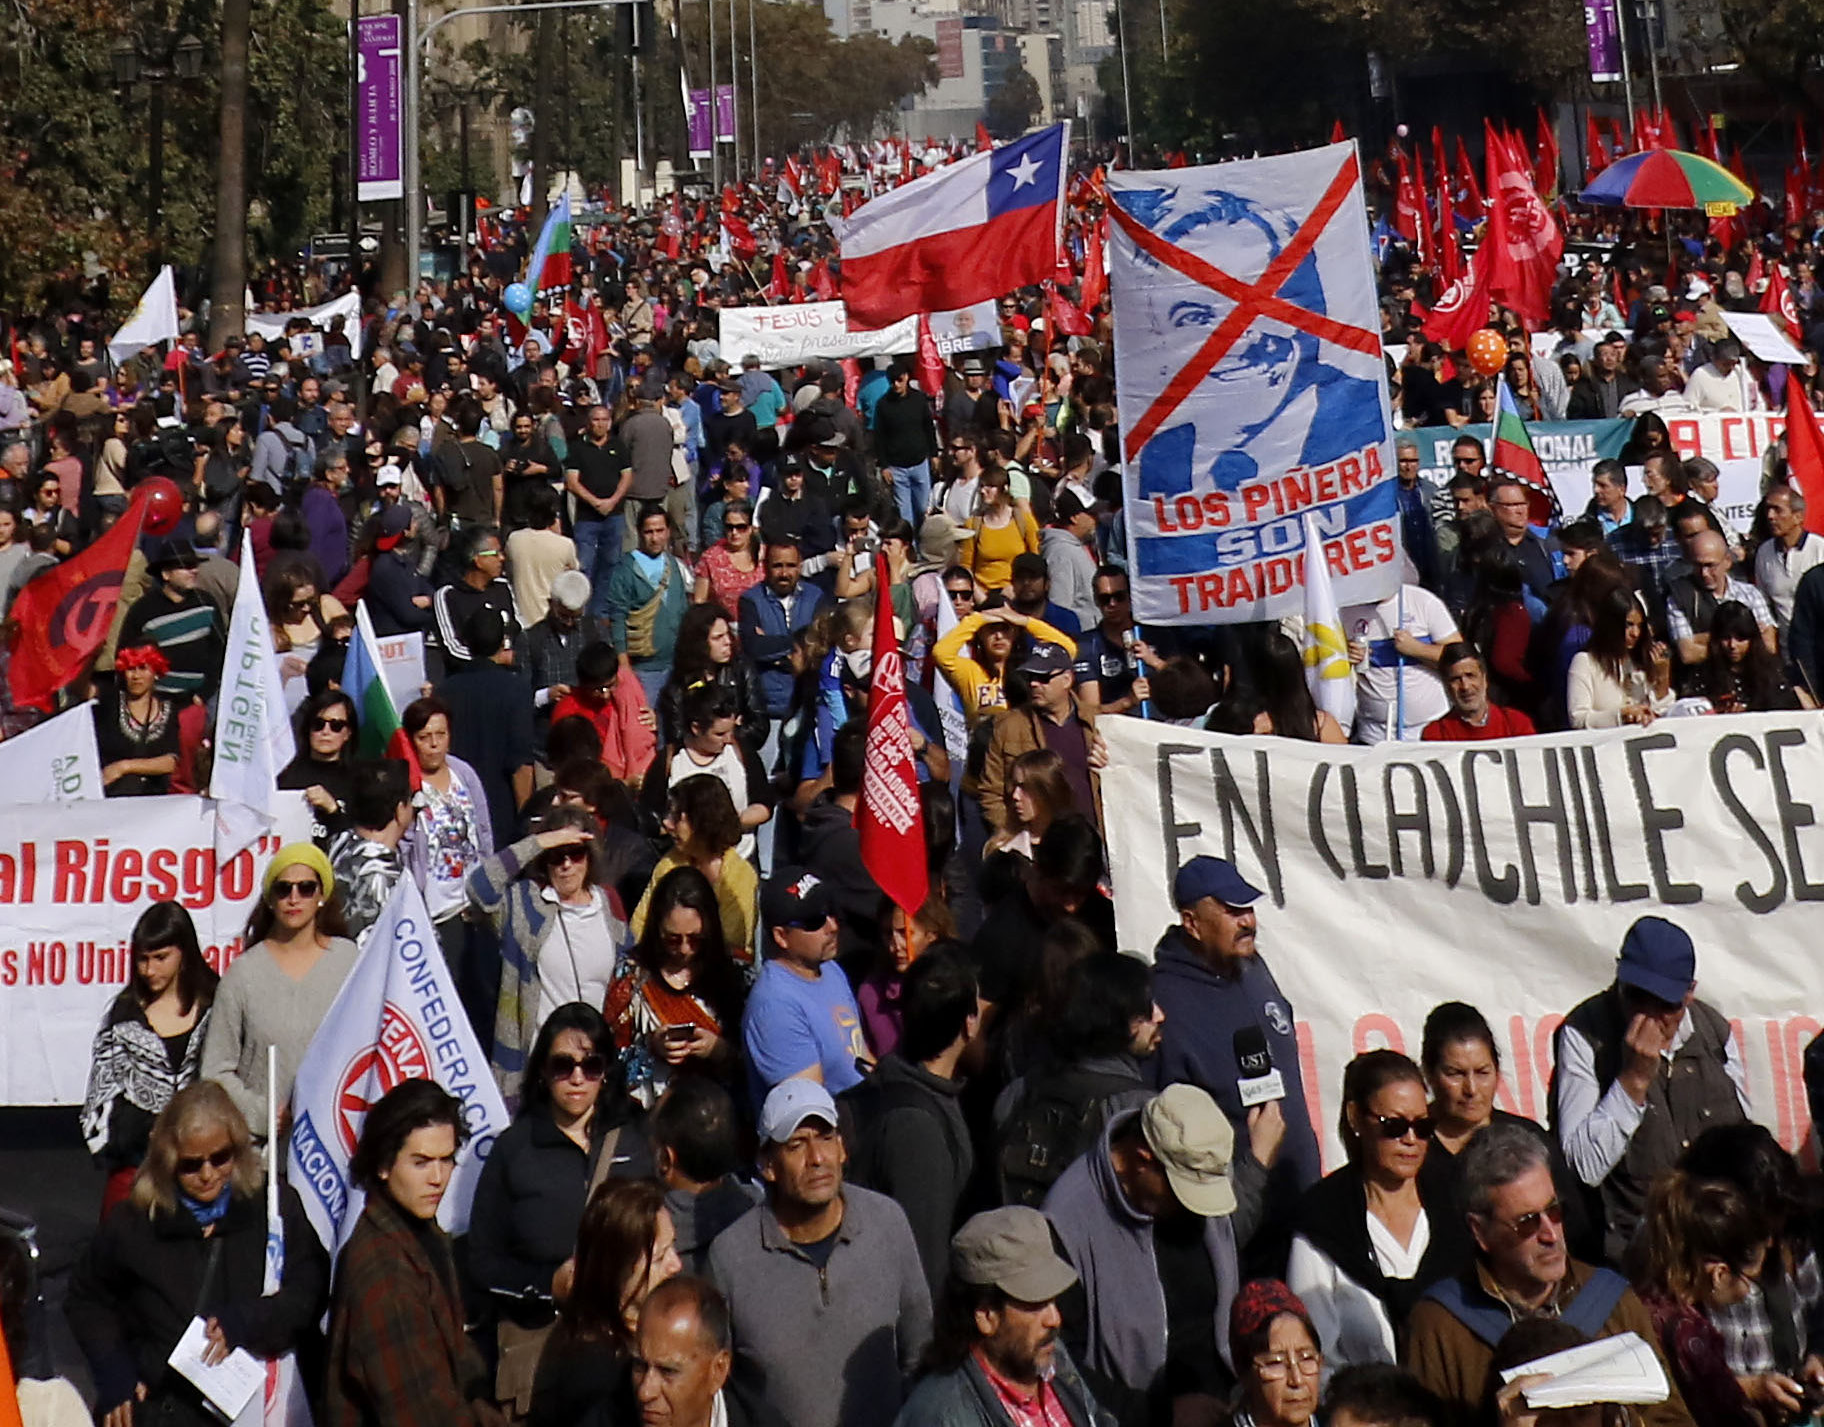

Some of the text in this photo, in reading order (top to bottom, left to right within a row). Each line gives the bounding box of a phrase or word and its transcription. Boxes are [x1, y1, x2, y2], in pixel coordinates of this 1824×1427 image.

[752, 309, 824, 333] JESUS
[931, 330, 954, 343] ULA
[937, 337, 974, 355] IBRE
[1153, 447, 1384, 534] LOS PIÑERA
[1216, 502, 1347, 565] SON
[1156, 742, 1285, 908] EN
[27, 941, 67, 986] NO
